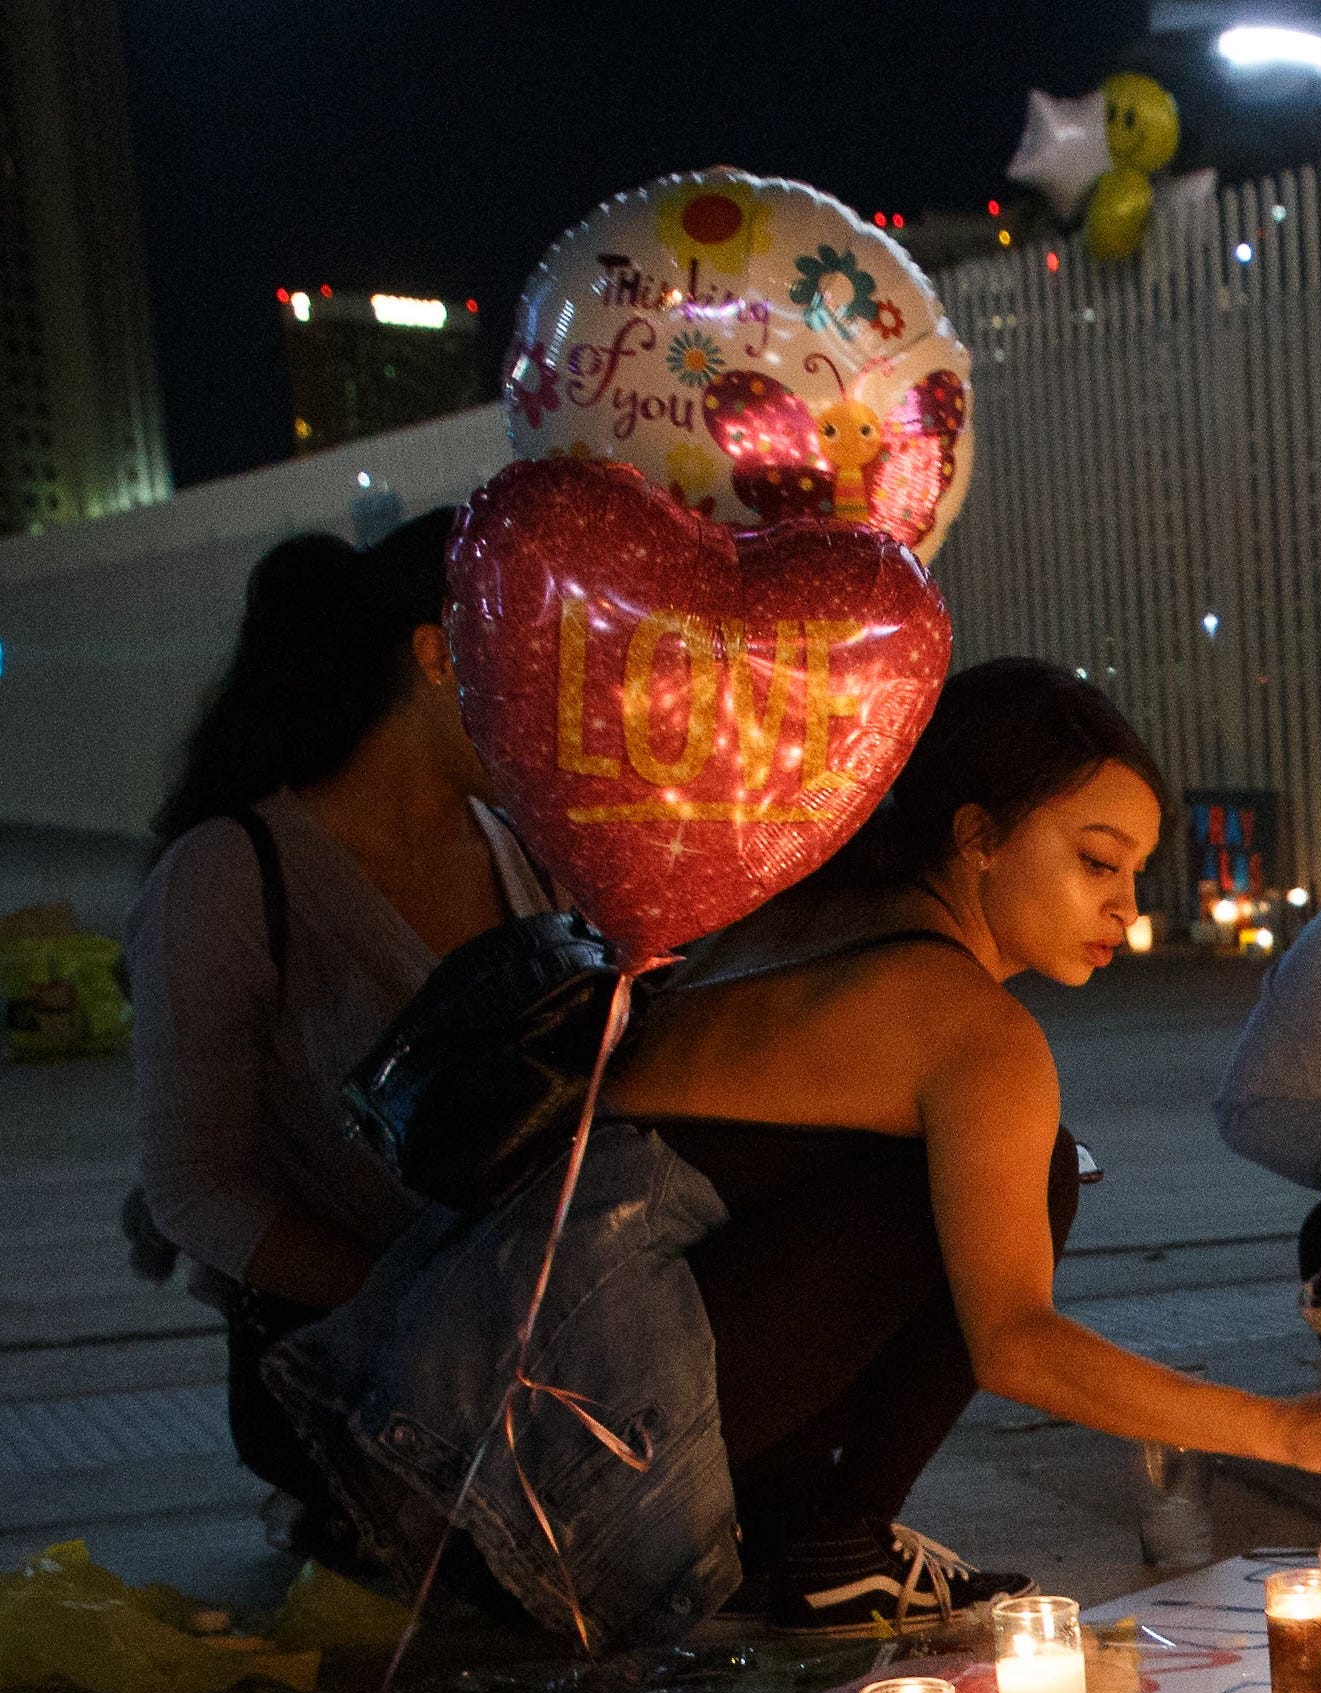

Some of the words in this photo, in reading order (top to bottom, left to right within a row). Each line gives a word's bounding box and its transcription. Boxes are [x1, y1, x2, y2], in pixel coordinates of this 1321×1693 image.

[569, 317, 655, 408] of
[613, 385, 696, 439] you
[556, 596, 864, 793] LOVE
